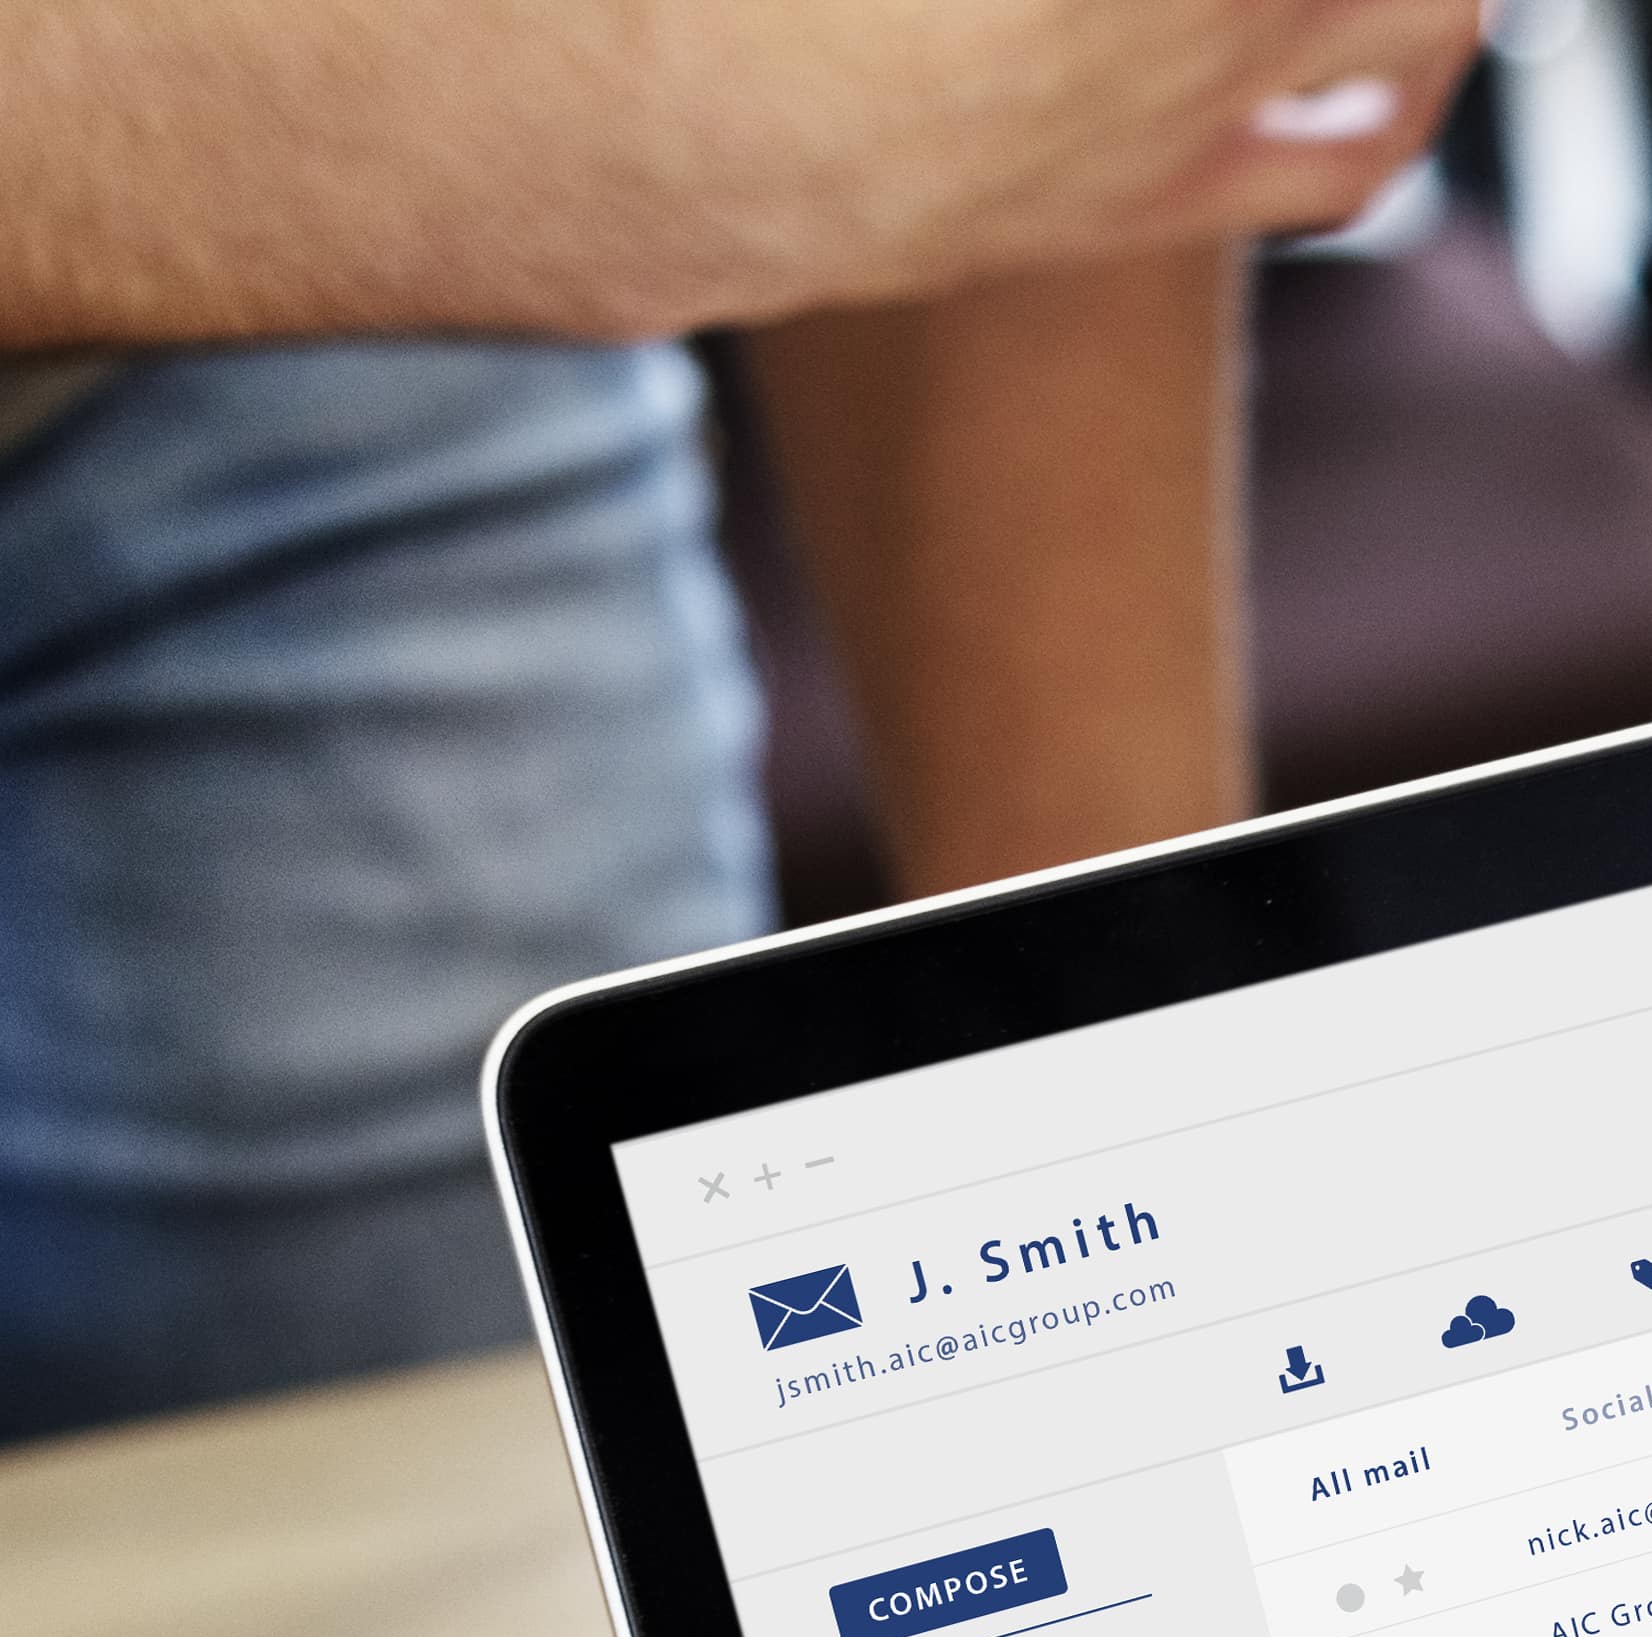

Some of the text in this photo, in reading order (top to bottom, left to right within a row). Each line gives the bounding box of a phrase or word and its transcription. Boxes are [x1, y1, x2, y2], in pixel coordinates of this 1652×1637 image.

[909, 1202, 1160, 1304] J. Smith
[775, 1280, 1176, 1409] jsmith.aic@aicgroup.com
[1311, 1446, 1431, 1502] All mail
[867, 1557, 1030, 1624] COMPOSE
